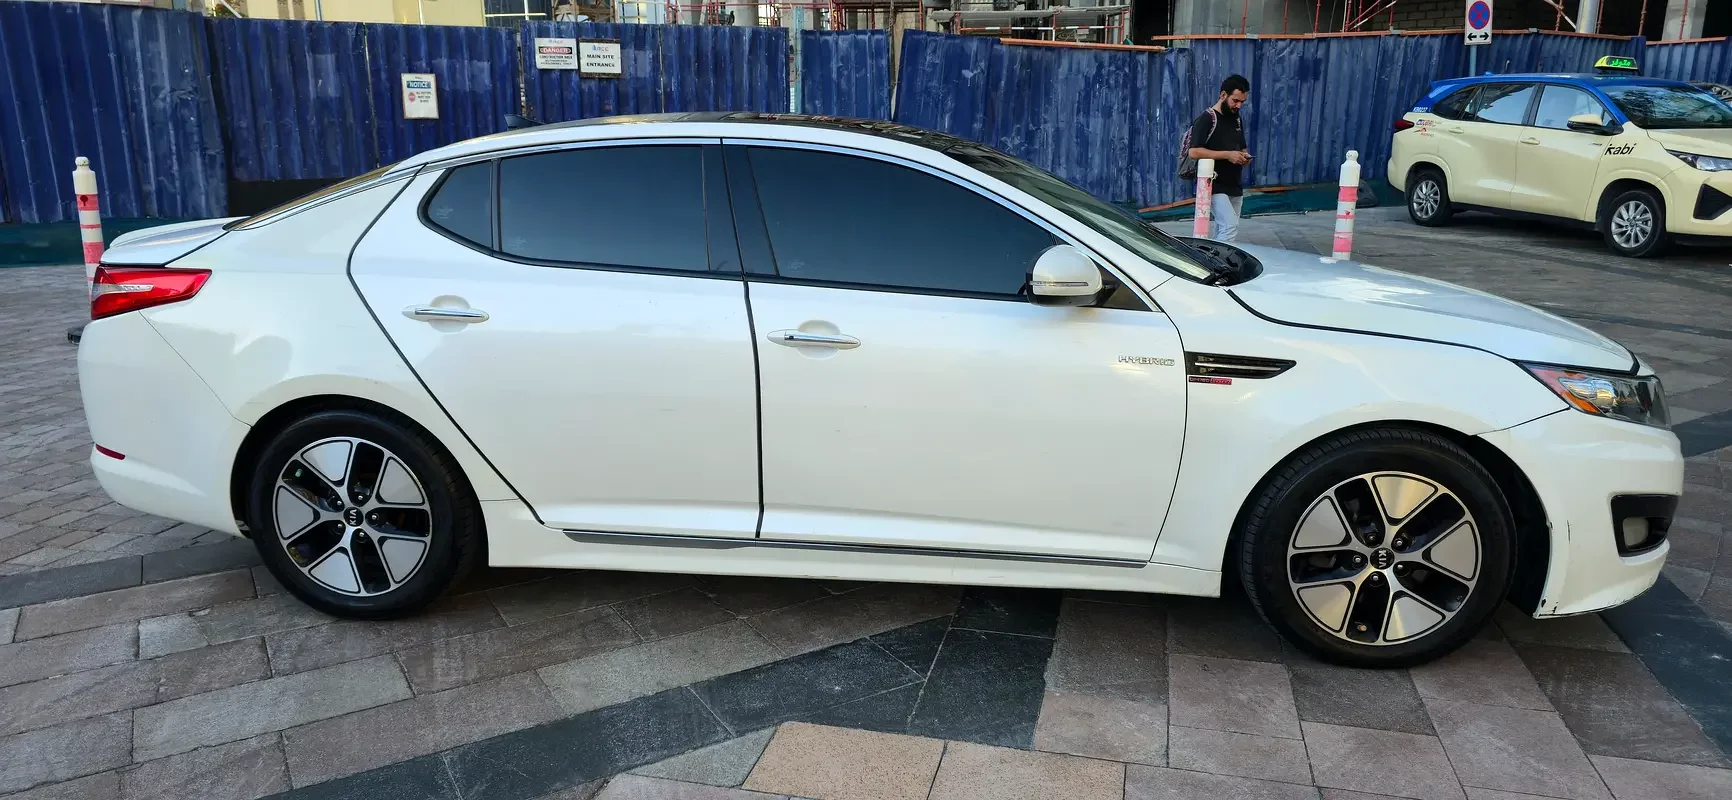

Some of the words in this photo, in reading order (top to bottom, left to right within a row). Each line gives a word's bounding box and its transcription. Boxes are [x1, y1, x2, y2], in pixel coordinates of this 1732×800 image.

[1610, 58, 1631, 67] متوفر
[1604, 143, 1636, 155] kabi
[1118, 355, 1175, 367] HYBRID
[349, 509, 357, 526] KIA
[1378, 550, 1387, 569] KIA
